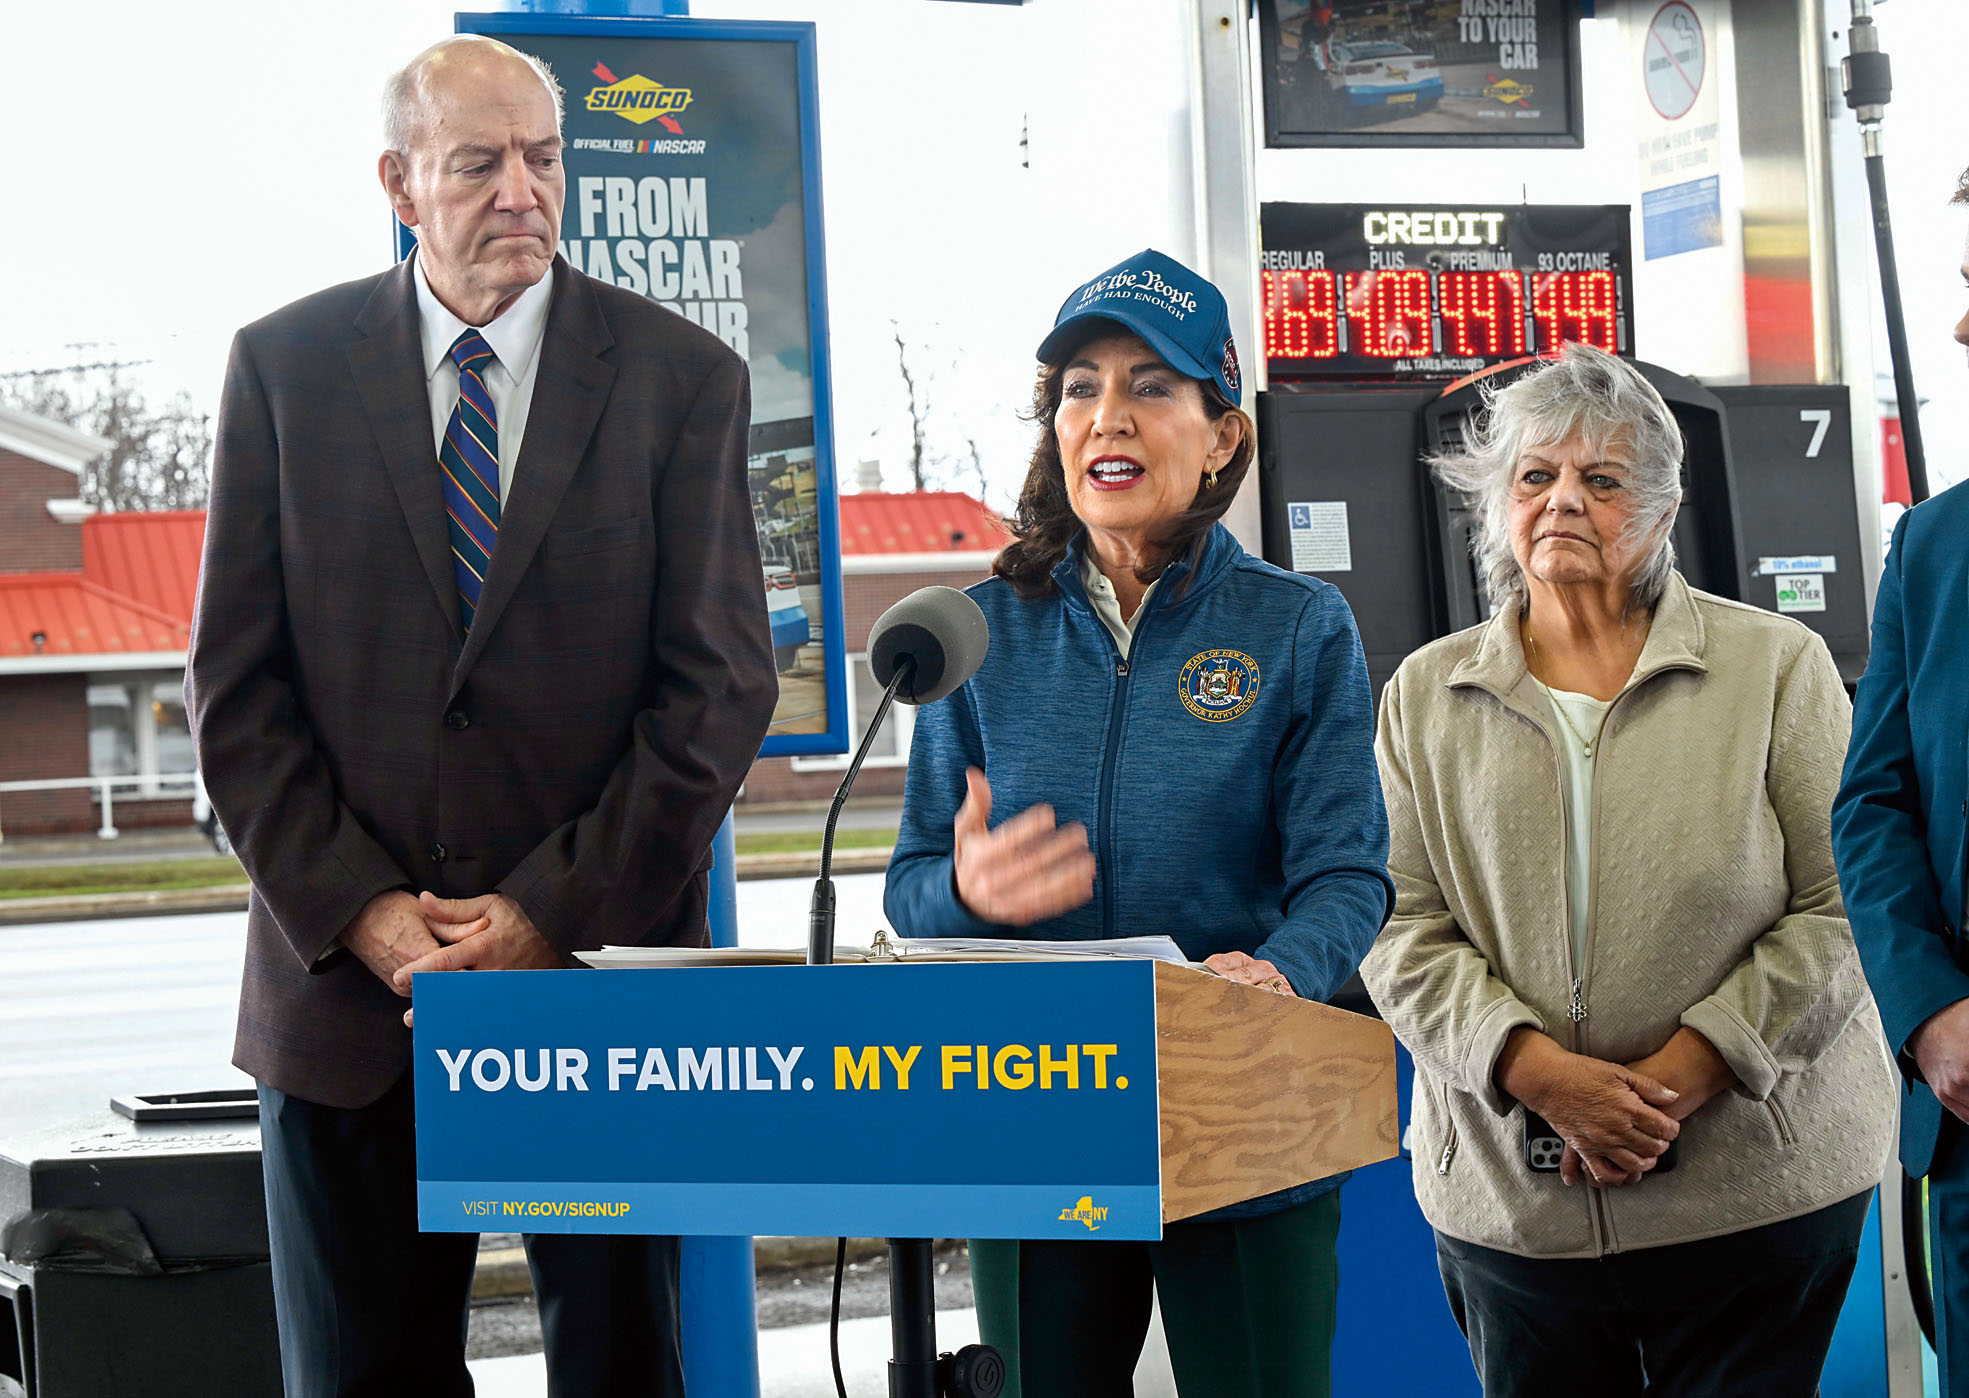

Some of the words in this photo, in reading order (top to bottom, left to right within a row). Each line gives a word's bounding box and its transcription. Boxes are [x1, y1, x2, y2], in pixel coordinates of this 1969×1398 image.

[1461, 0, 1536, 16] NASCAR
[1458, 17, 1482, 43] TO
[1486, 17, 1537, 43] YOUR
[1500, 43, 1538, 69] CAR
[590, 90, 688, 109] SUNOCO
[573, 138, 611, 149] OFFICIAL
[613, 139, 634, 149] FUEL
[654, 139, 706, 154] NASCAR
[578, 176, 709, 238] FROM
[1363, 211, 1504, 245] CREDIT
[1262, 250, 1325, 270] REGULAR
[1370, 251, 1405, 270] PLUS
[1450, 252, 1513, 270] PREMIUM
[1538, 253, 1553, 271] 93
[1556, 252, 1611, 270] OCTANE
[1079, 280, 1107, 303] We
[1102, 269, 1137, 290] the
[1131, 270, 1197, 313] People
[1074, 293, 1103, 313] HAVE
[1103, 290, 1132, 299] HAD
[1133, 292, 1185, 321] ENOUGH
[1394, 359, 1412, 371] ALL
[1413, 359, 1441, 371] TAXES
[1800, 410, 1831, 457] 7
[1789, 579, 1811, 590] TOP
[1799, 590, 1820, 600] TIER
[1185, 652, 1208, 671] STATE
[1222, 650, 1242, 658] NEW
[1242, 656, 1257, 673] YORK
[1180, 687, 1207, 718] GOVERNOR
[1207, 709, 1234, 719] KATHY
[1234, 690, 1256, 715] HOCHUL
[436, 1047, 590, 1093] YOUR
[607, 1046, 815, 1092] FAMILY.
[833, 1045, 923, 1091] MY
[941, 1044, 1129, 1091] FIGHT.
[462, 1201, 499, 1216] VISIT
[503, 1201, 631, 1217] NY.GOV/SIGNUP
[1063, 1210, 1076, 1220] WE
[1078, 1210, 1092, 1220] ARE
[1093, 1206, 1108, 1221] NY
